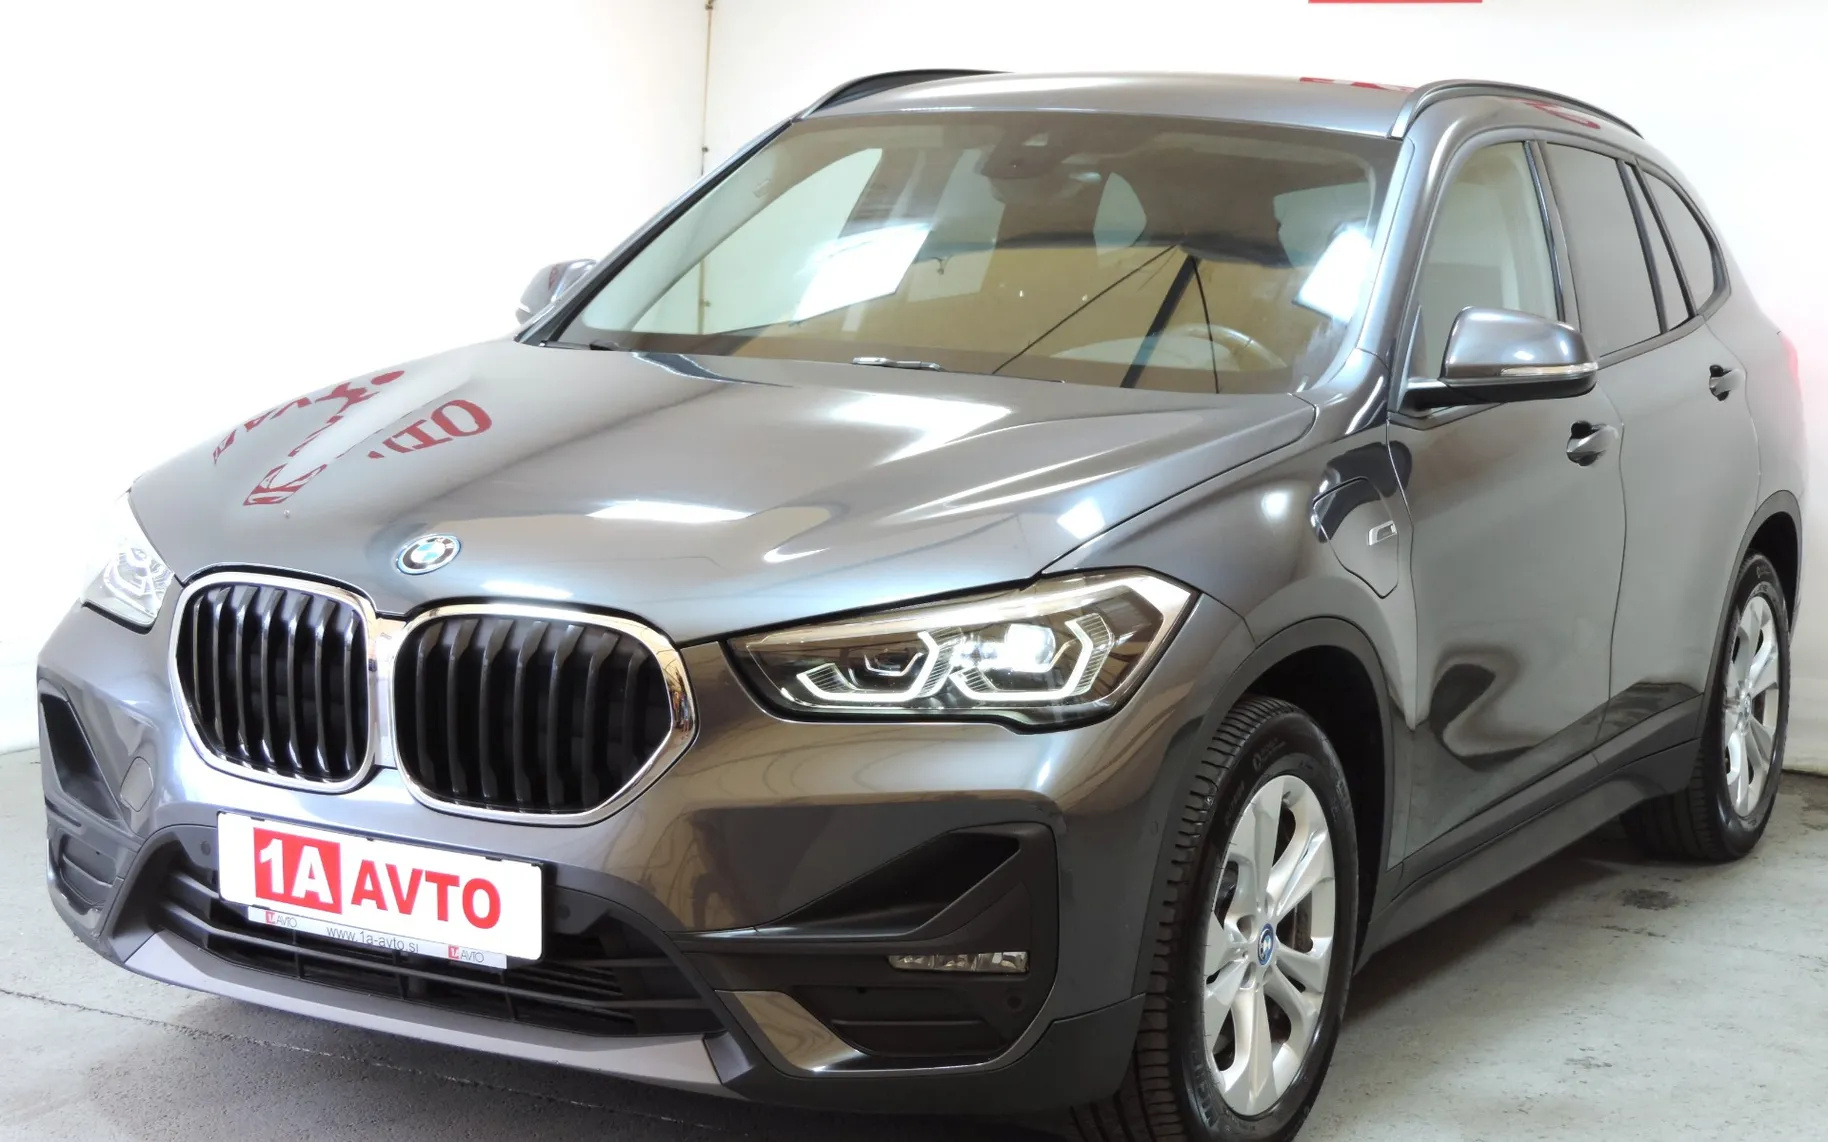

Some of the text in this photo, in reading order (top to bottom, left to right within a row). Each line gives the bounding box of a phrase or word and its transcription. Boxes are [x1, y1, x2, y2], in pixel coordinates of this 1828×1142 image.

[259, 838, 502, 930] 1A AVTO
[326, 926, 419, 954] www.1a-avto.si
[460, 949, 485, 964] AVTO
